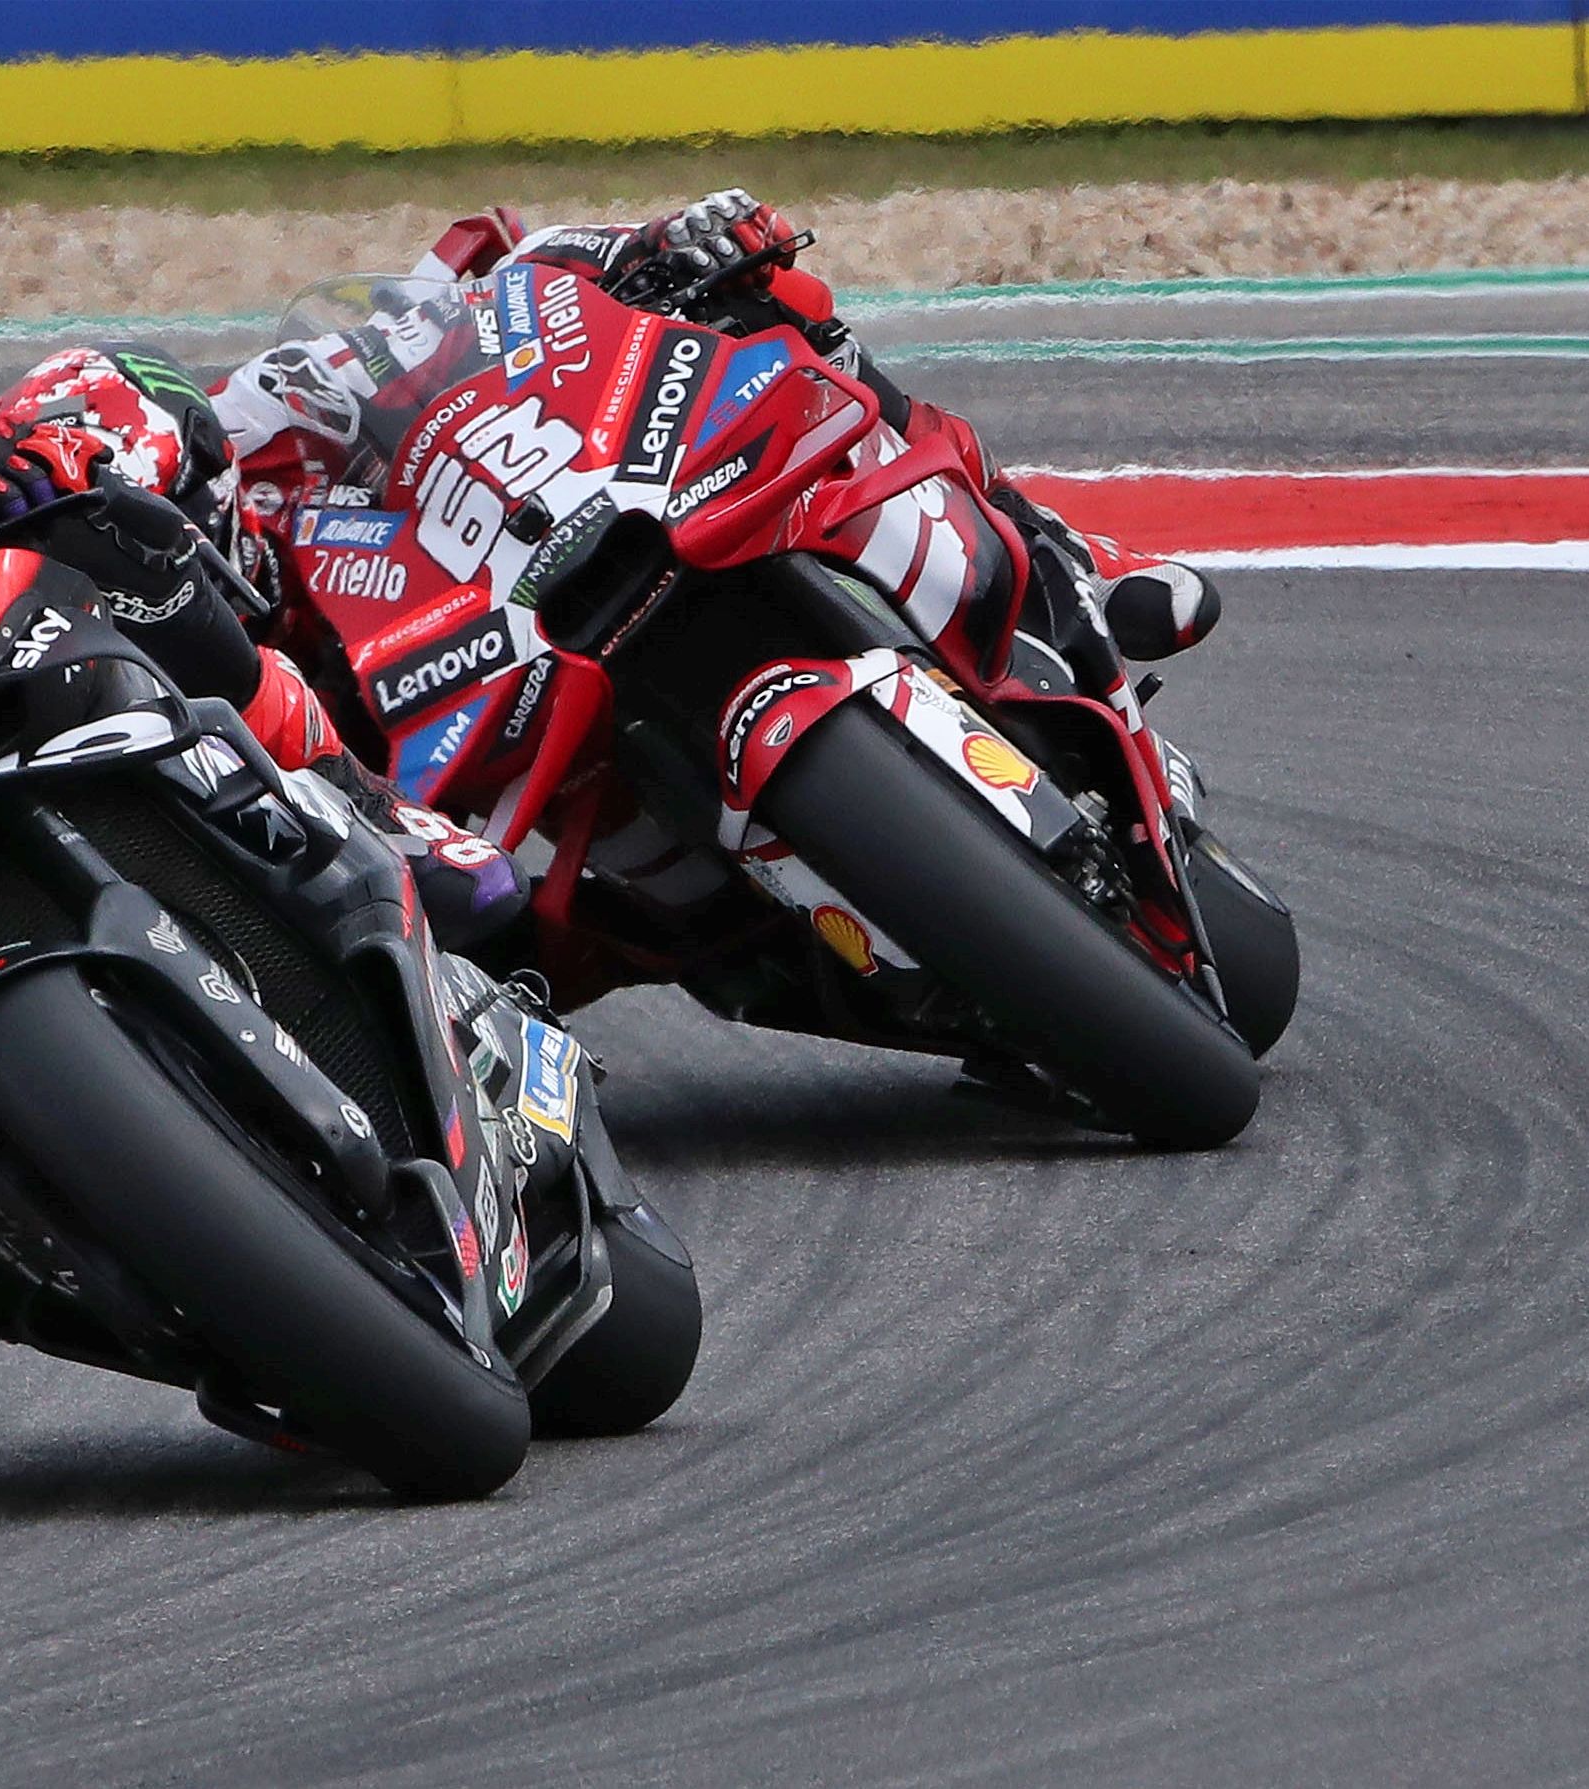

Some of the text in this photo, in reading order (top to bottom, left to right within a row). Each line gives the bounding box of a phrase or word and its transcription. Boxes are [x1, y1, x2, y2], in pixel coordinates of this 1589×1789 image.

[474, 308, 502, 355] WRS
[506, 271, 533, 336] ADVANCE
[540, 273, 588, 352] riello
[603, 316, 651, 423] FRECCIAROSSA
[735, 359, 787, 402] TIM
[398, 389, 478, 487] VARGROUP
[627, 337, 702, 475] Lenovo
[328, 485, 373, 507] WRS
[415, 396, 583, 584] 63
[666, 456, 749, 519] CARRERA
[317, 518, 392, 546] ADVANCE
[527, 495, 613, 582] MONSTER
[326, 553, 408, 602] riello
[12, 607, 72, 669] sky
[374, 629, 505, 714] Lenovo
[506, 657, 554, 739] CARRERA
[727, 672, 820, 786] Lenovo
[429, 710, 473, 765] TIM
